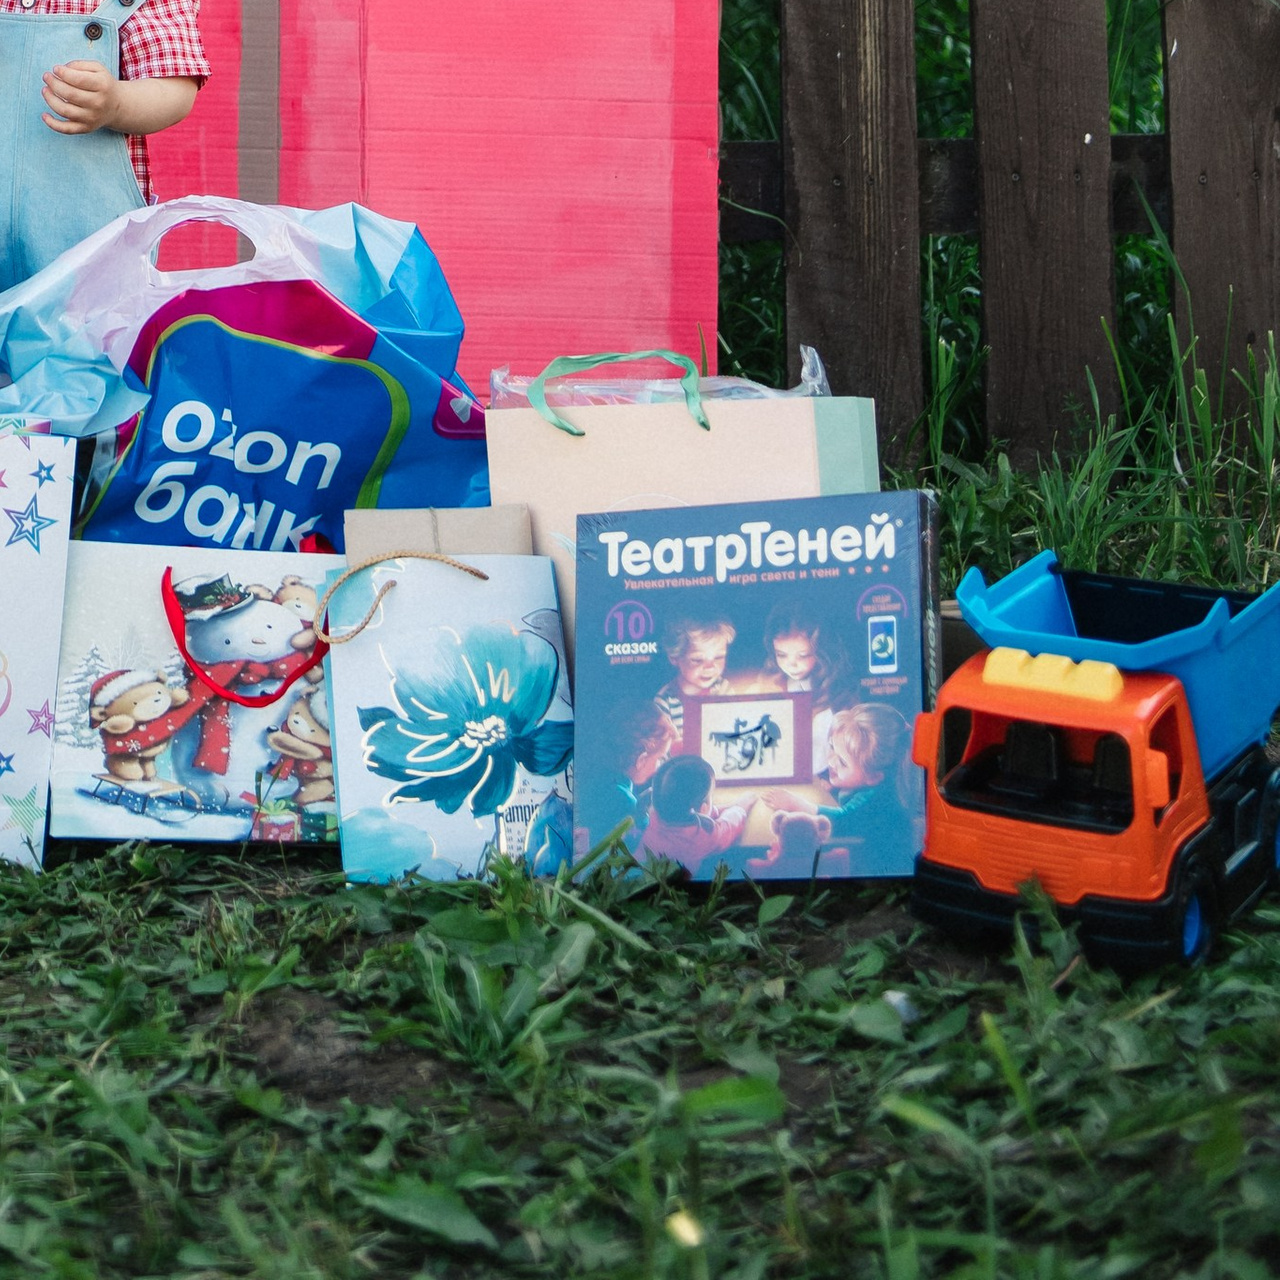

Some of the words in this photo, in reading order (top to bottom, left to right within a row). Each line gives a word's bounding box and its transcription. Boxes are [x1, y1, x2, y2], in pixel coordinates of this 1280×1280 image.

[598, 512, 897, 583] ТеатрТеней
[623, 575, 714, 591] Увлекательная
[729, 572, 757, 586] игра
[761, 569, 796, 582] света
[799, 568, 807, 579] и
[811, 567, 840, 578] тени
[613, 610, 646, 641] 10
[604, 642, 658, 656] сказок
